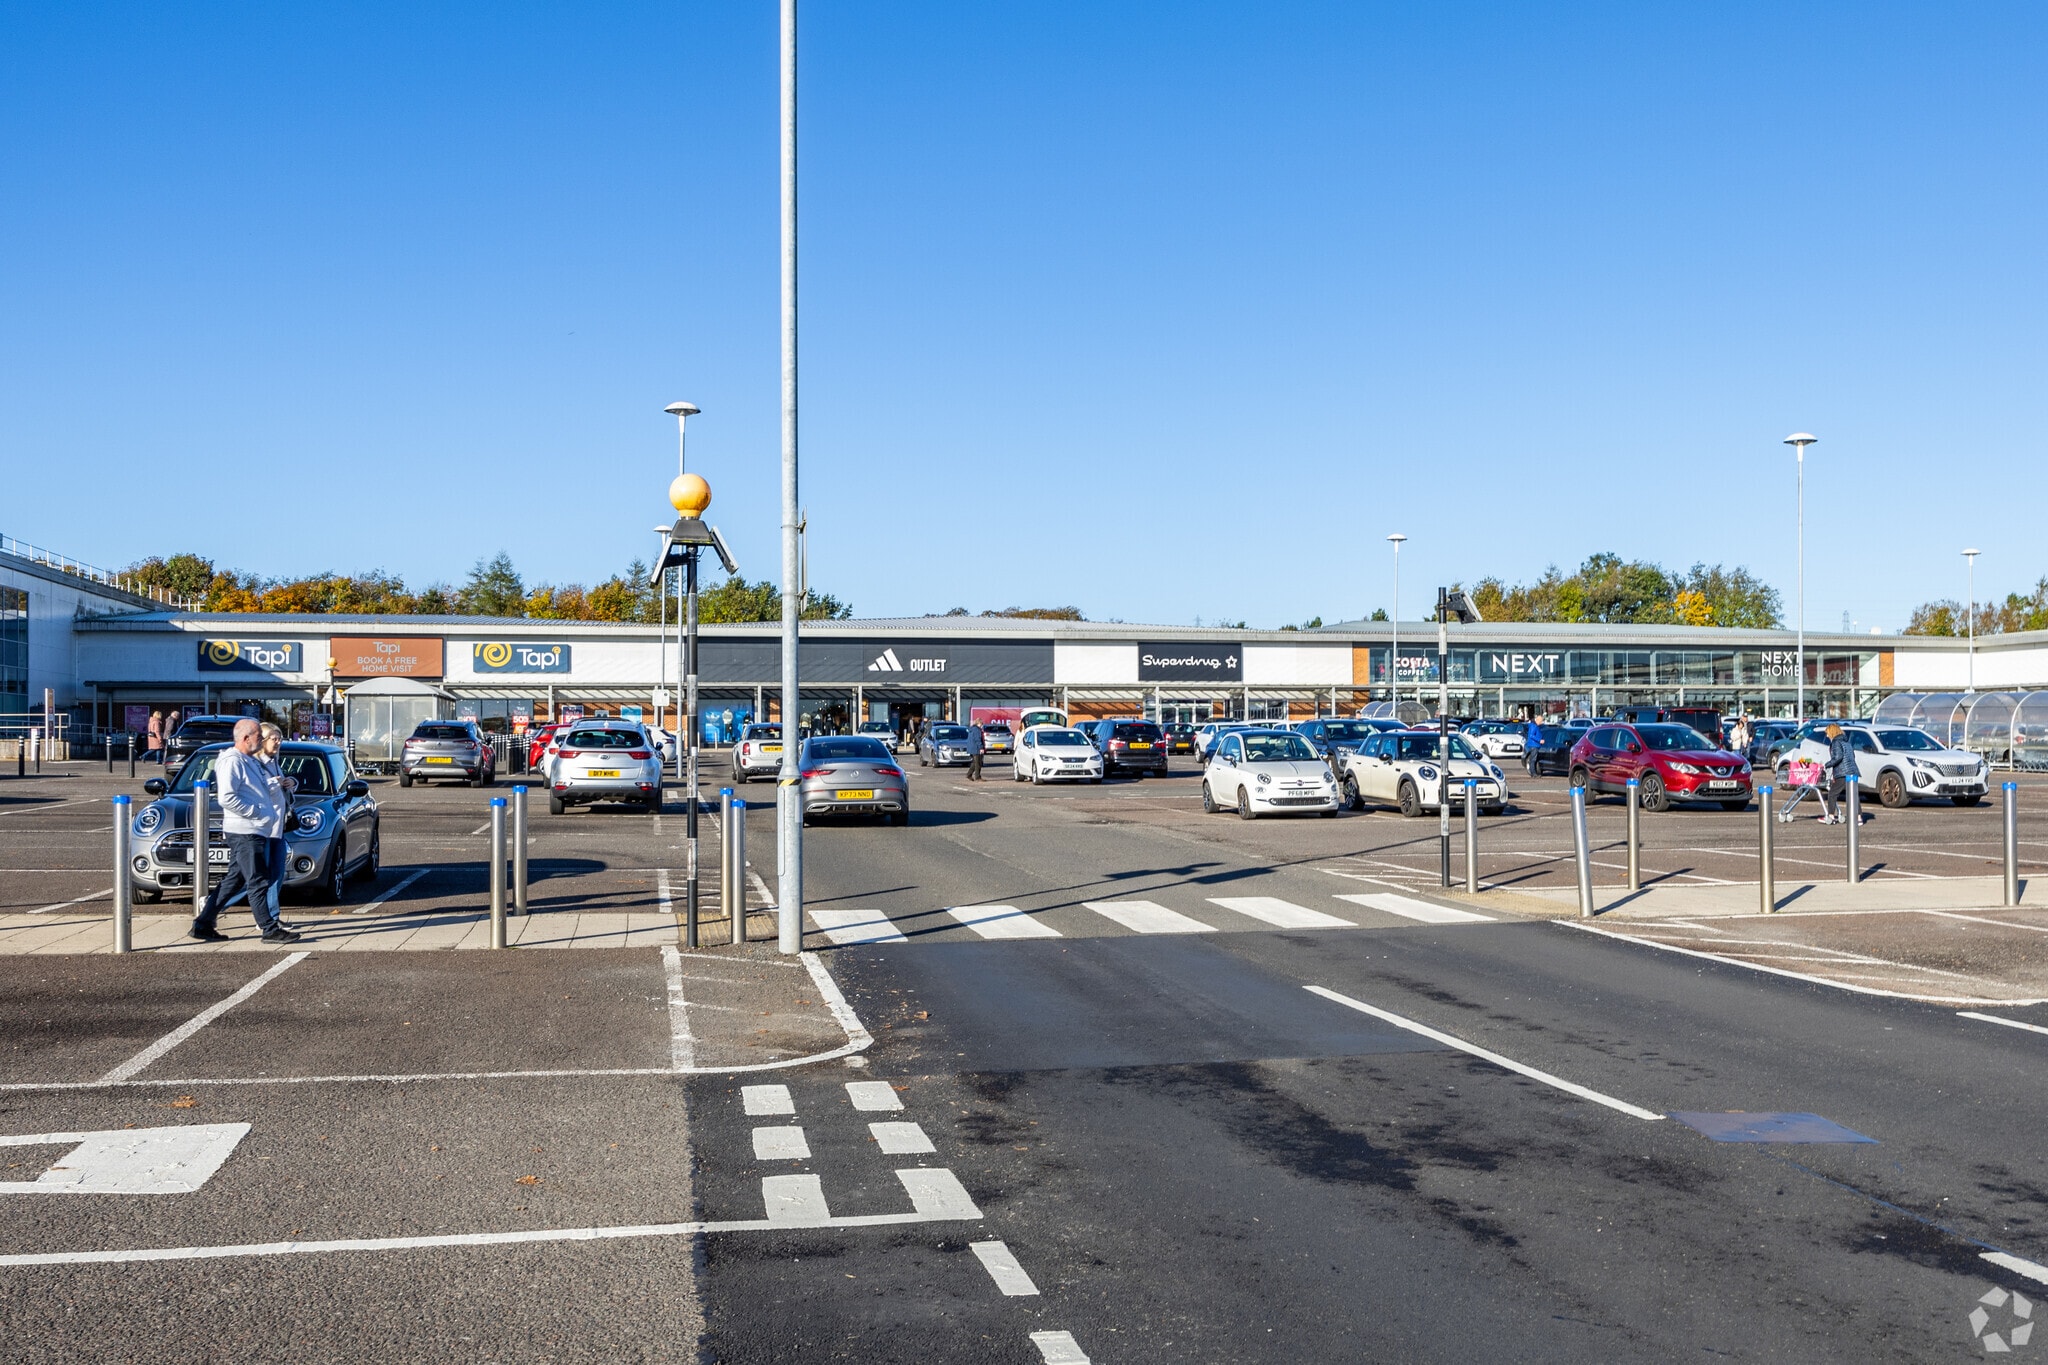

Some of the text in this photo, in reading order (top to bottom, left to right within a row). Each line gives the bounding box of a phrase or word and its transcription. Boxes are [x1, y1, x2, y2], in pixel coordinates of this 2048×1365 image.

[372, 641, 401, 654] Tapi
[244, 643, 292, 669] Tapi
[357, 656, 417, 664] BOOK A FREE
[516, 645, 562, 670] Tapi
[1142, 654, 1222, 669] Superdrug
[1394, 657, 1430, 668] COSTA
[1761, 651, 1799, 664] NEXT
[362, 665, 413, 673] HOME VISIT
[910, 658, 947, 672] OUTLET
[1492, 654, 1559, 673] NEXT
[1761, 664, 1799, 677] HOME
